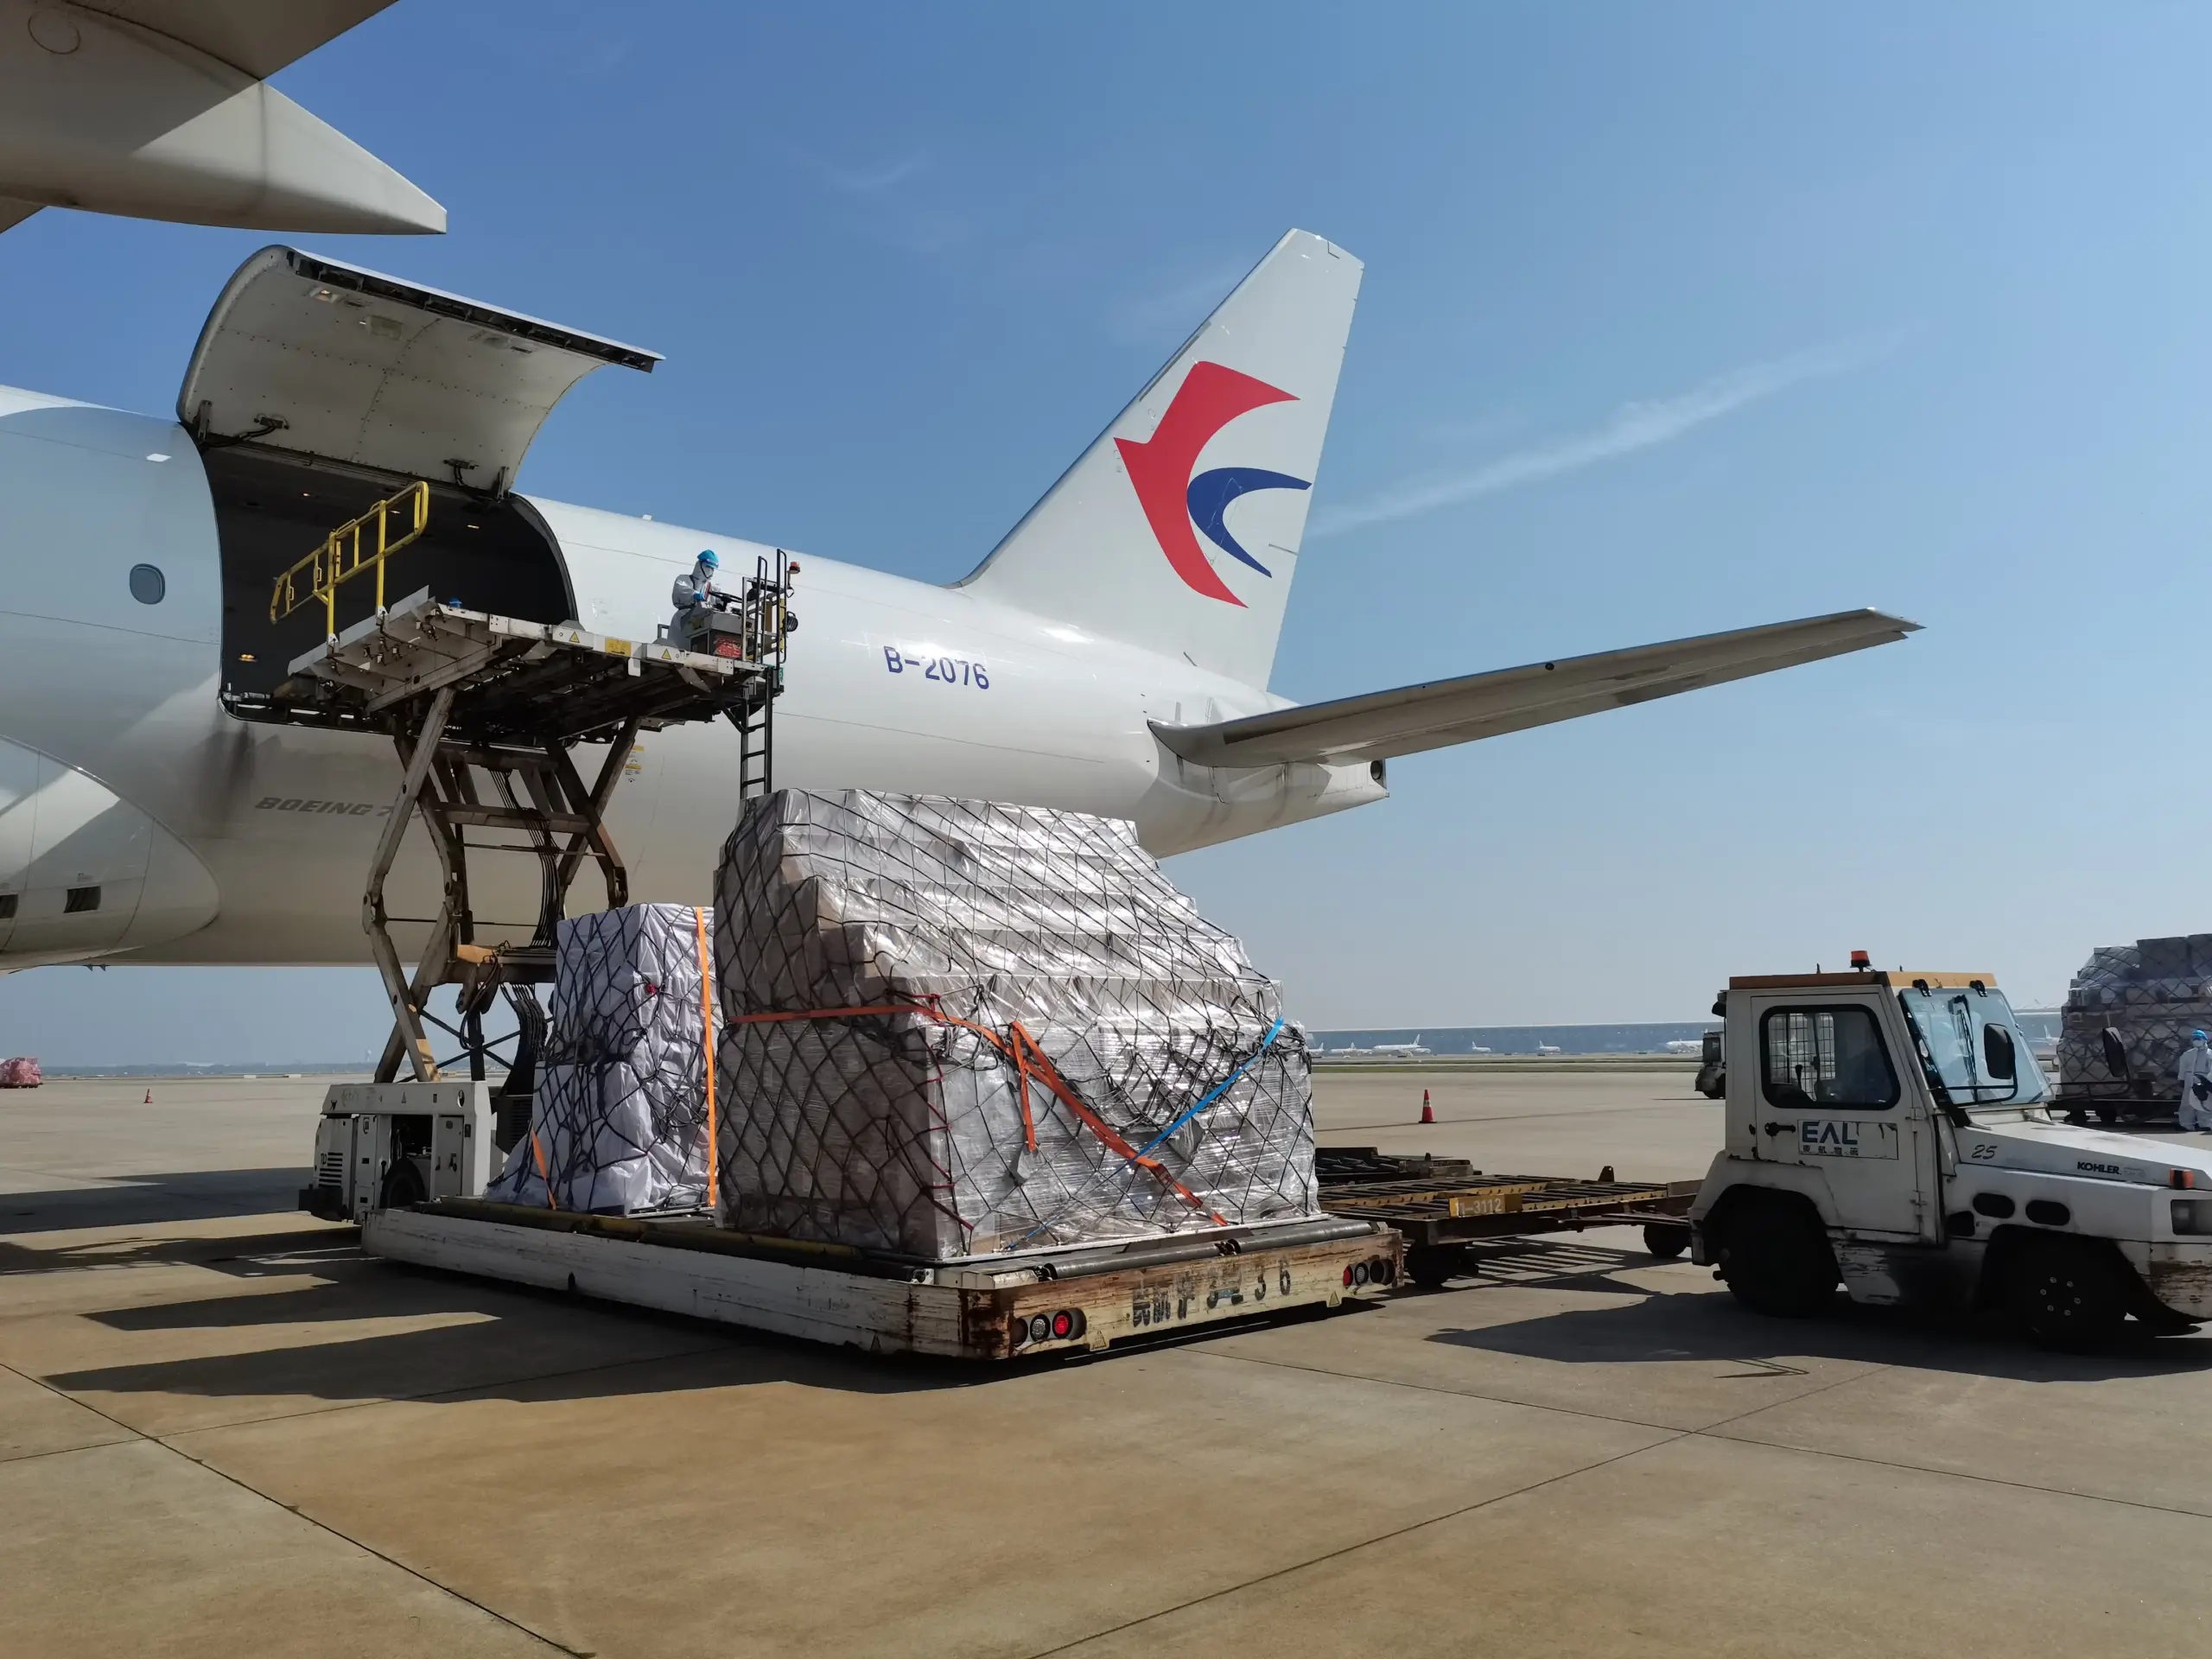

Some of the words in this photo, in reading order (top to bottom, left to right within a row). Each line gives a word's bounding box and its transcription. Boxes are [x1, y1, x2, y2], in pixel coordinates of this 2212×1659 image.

[883, 645, 990, 690] B-2076
[255, 797, 373, 816] BOEING
[1802, 1121, 1859, 1146] EAL
[1971, 1143, 1999, 1160] 25
